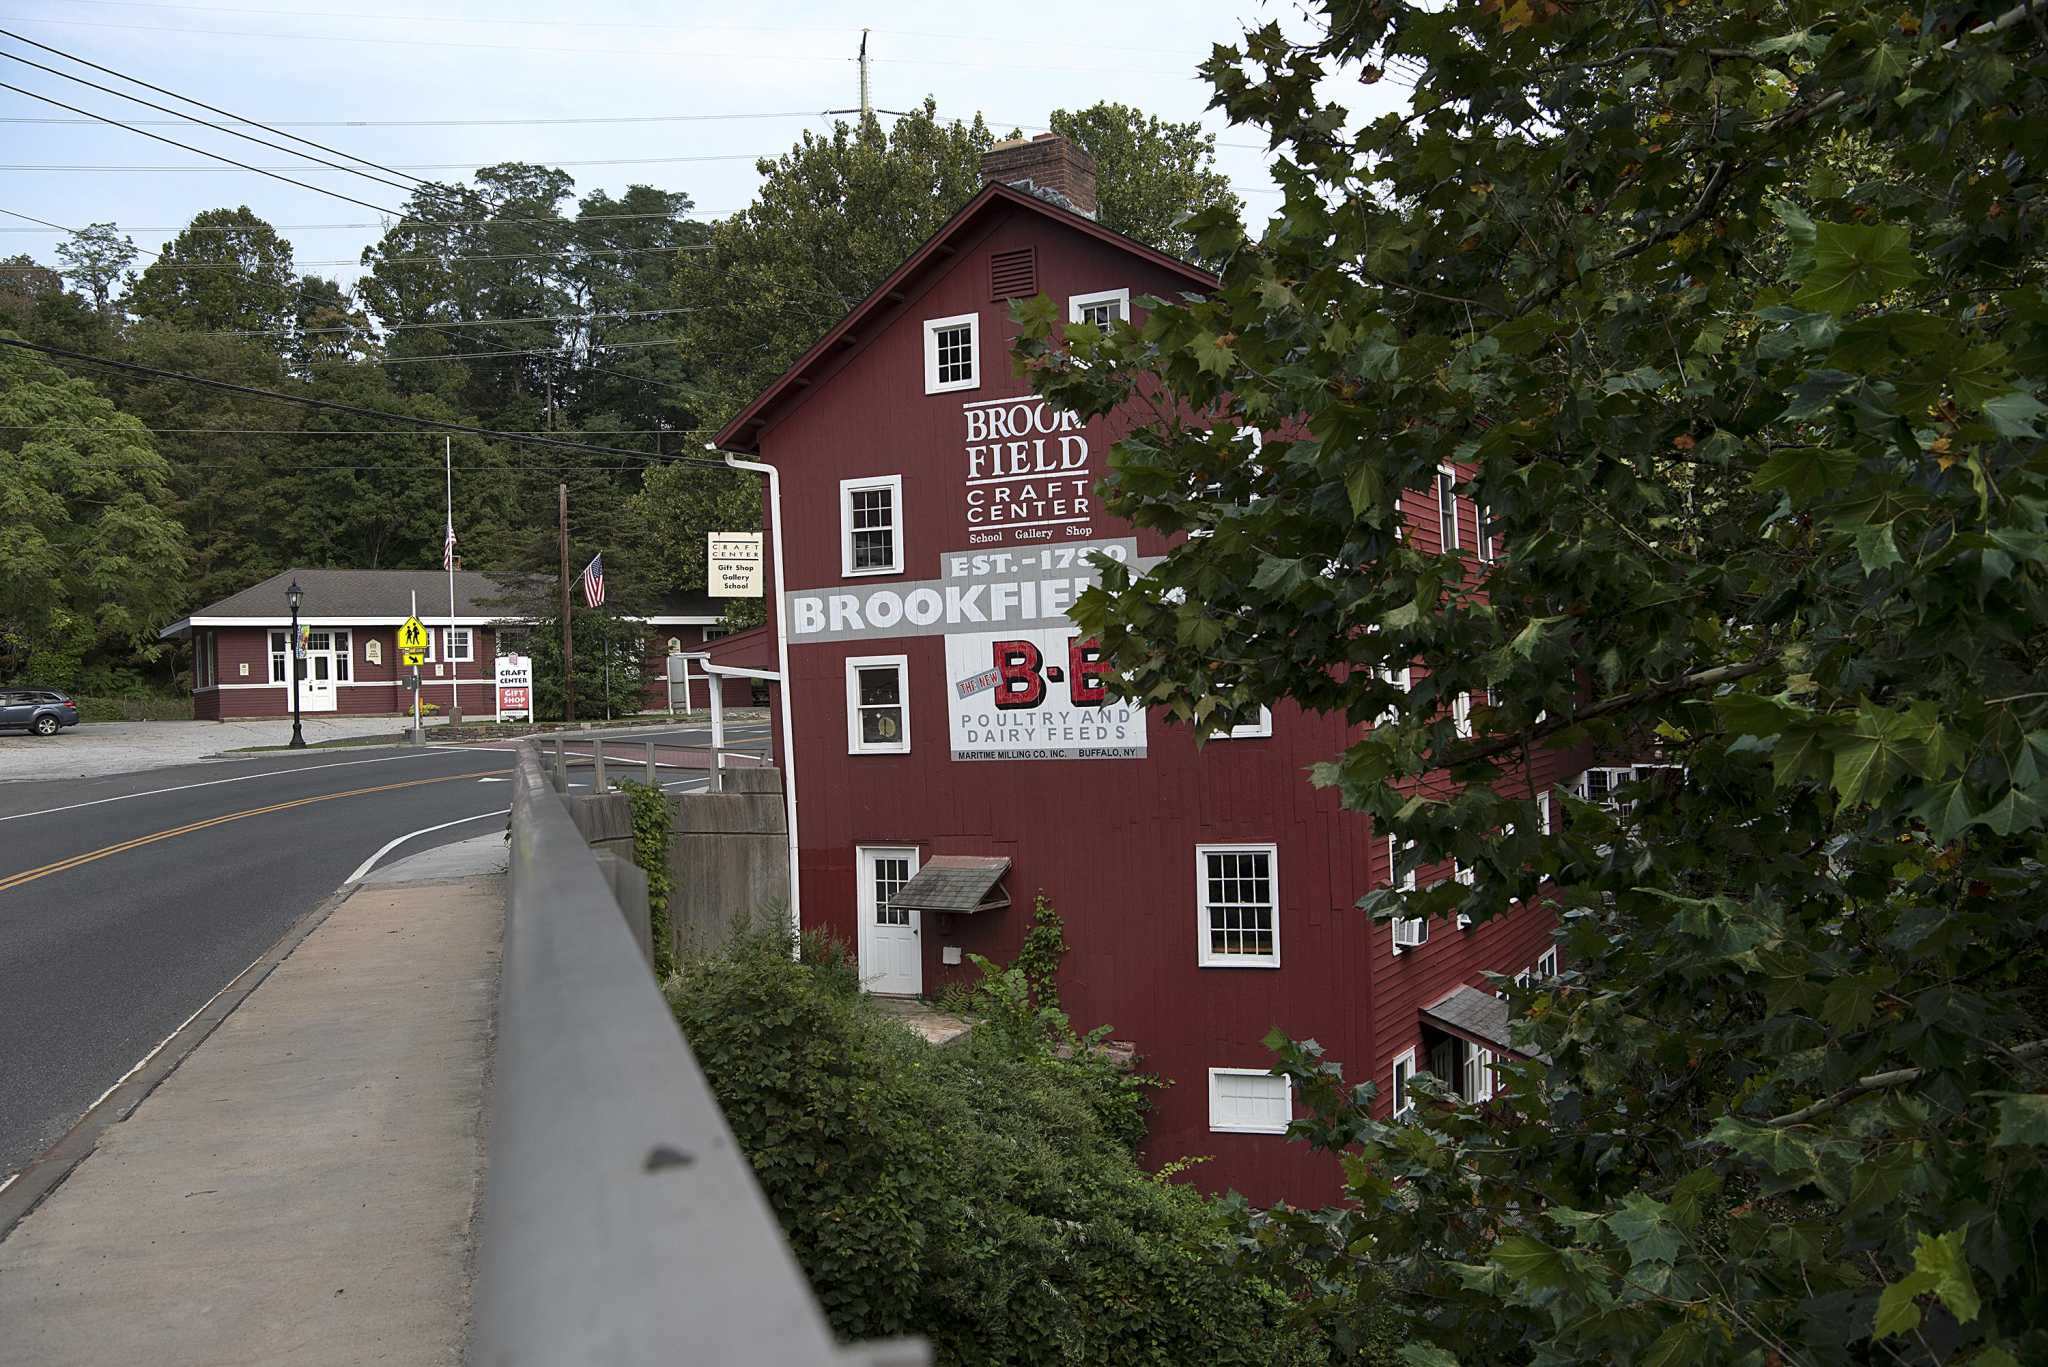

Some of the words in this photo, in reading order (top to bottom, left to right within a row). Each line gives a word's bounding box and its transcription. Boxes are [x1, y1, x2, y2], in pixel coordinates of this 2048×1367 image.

[965, 435, 1089, 478] FIELD
[967, 480, 1089, 506] CRAFT
[967, 498, 1089, 523] CENTER
[969, 532, 1003, 544] School
[1015, 529, 1053, 540] Gallery
[1066, 526, 1092, 537] Shop
[736, 564, 754, 572] Shop
[722, 574, 750, 582] Gallery
[960, 680, 976, 696] THE
[978, 670, 998, 688] NEW
[962, 711, 1071, 728] POULTRY
[1081, 709, 1130, 724] AND
[968, 729, 1036, 743] DAIRY
[1048, 726, 1126, 742] FEEDS
[958, 751, 996, 760] MARITIME
[997, 750, 1031, 760] MILLING
[1033, 750, 1048, 759] CO.
[1050, 749, 1067, 758] INC.
[1079, 748, 1121, 758] BUFFALO,
[1124, 748, 1136, 757] NY
